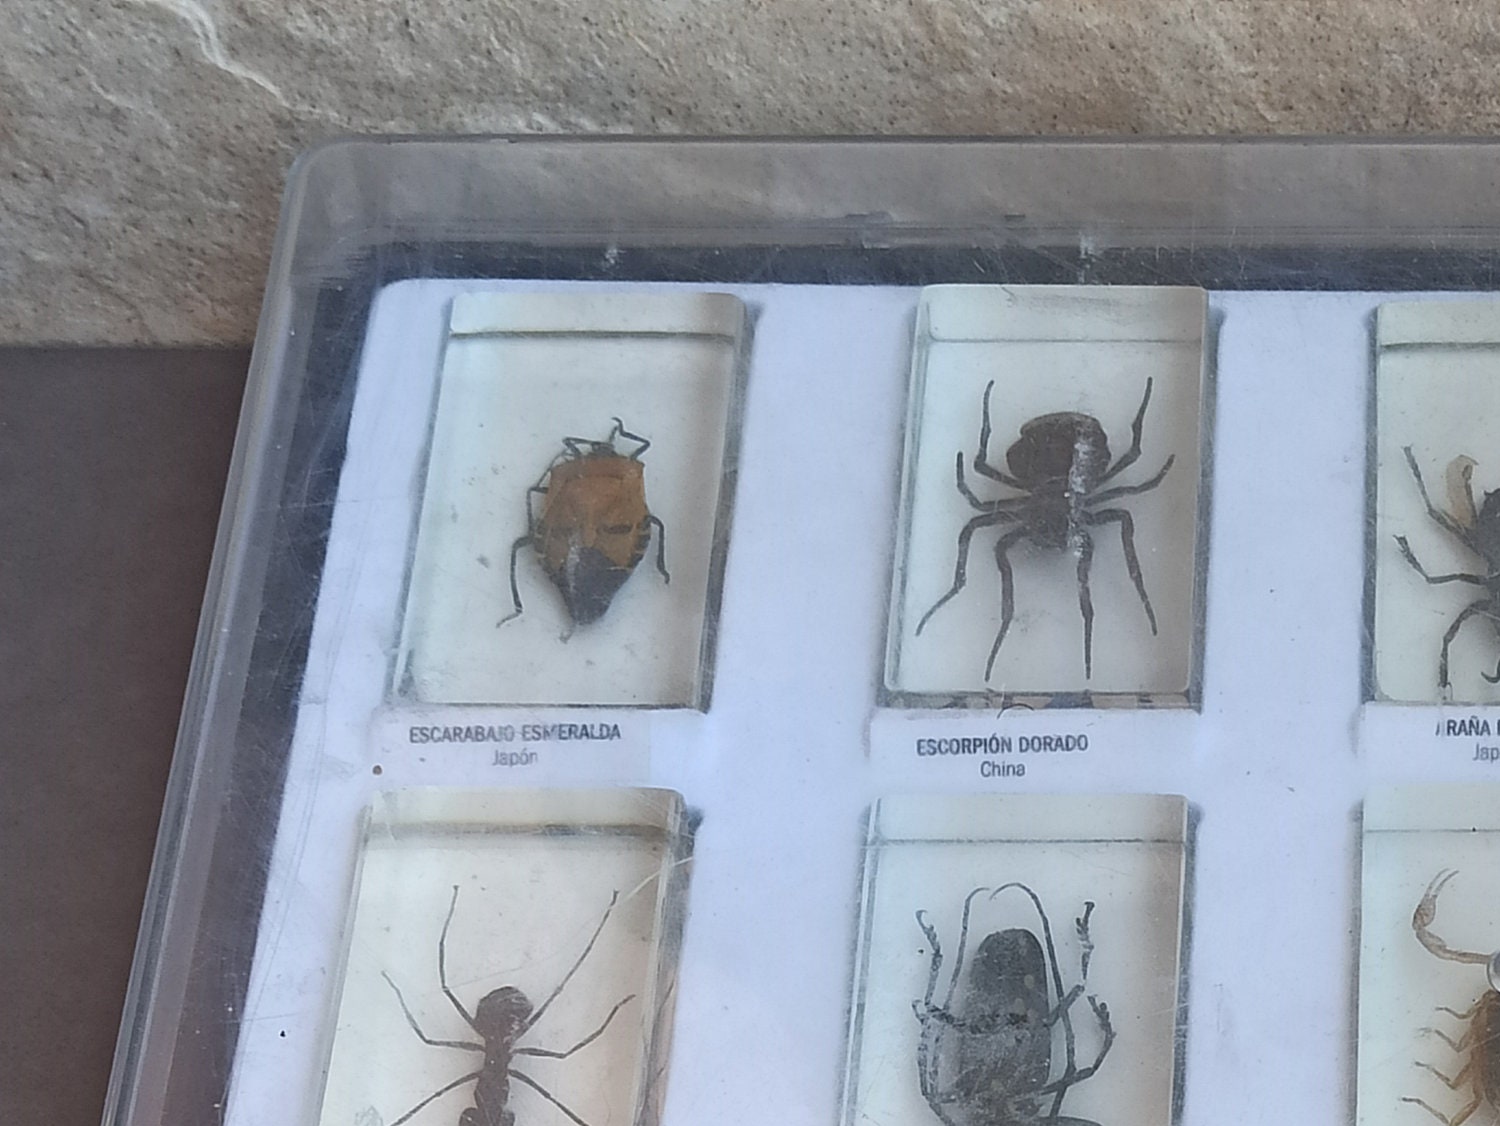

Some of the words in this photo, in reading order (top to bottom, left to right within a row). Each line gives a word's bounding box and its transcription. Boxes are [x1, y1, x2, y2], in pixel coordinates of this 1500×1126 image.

[409, 725, 515, 744] ESCARABAJO
[522, 723, 622, 742] ESMERALDA
[916, 734, 1012, 757] ESCORPIÓN
[1019, 734, 1089, 754] DORADO
[492, 748, 539, 767] Japón
[980, 760, 1026, 778] China
